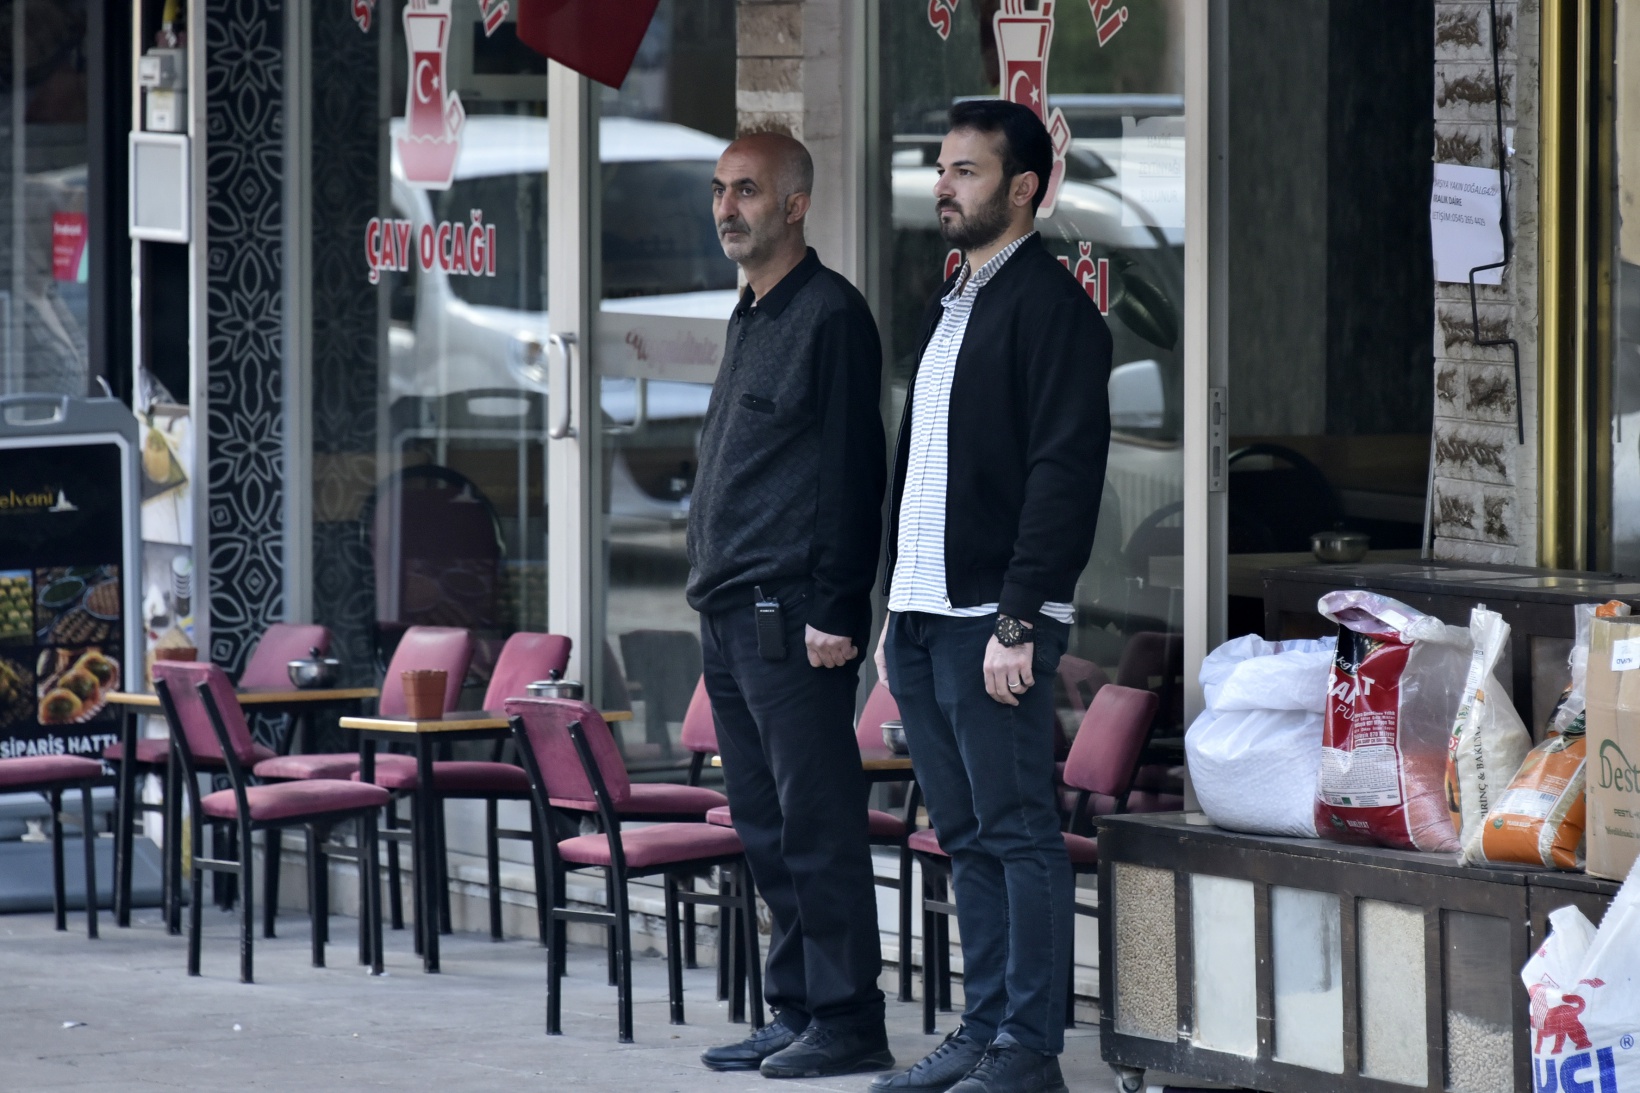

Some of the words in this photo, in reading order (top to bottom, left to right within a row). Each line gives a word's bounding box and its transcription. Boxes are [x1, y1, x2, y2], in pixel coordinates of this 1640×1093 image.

[365, 217, 412, 284] ÇAY
[419, 208, 496, 276] OCAĞI
[1477, 772, 1485, 780] &
